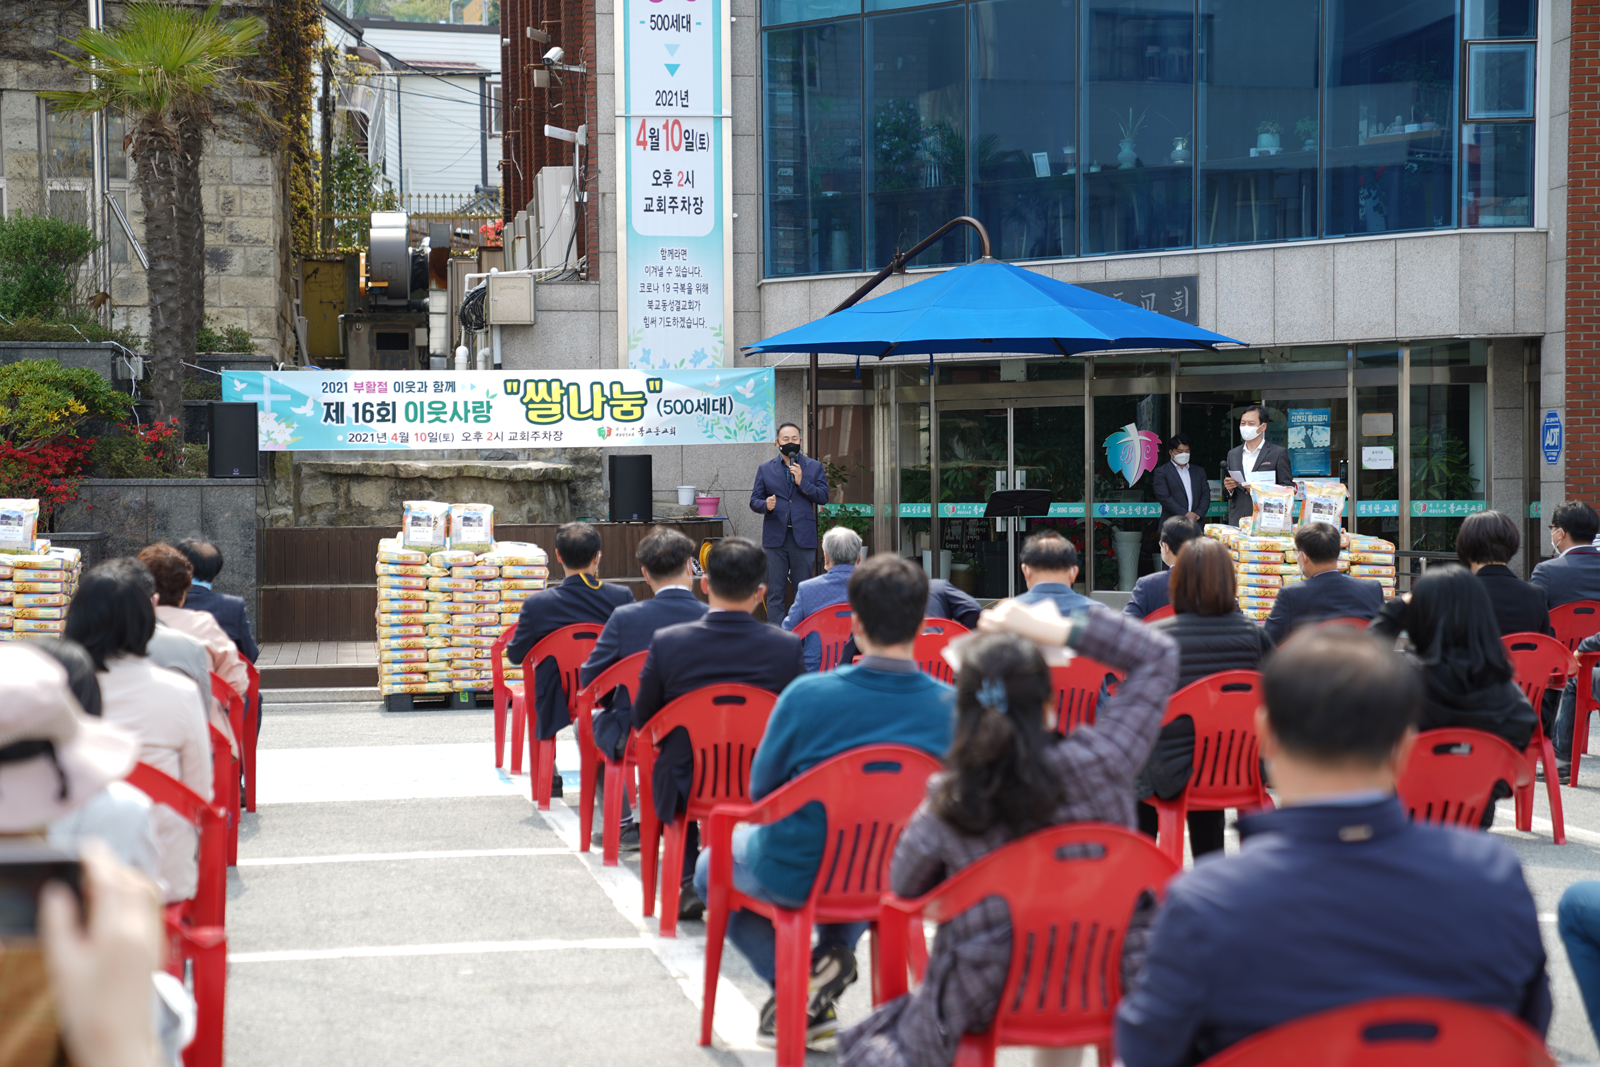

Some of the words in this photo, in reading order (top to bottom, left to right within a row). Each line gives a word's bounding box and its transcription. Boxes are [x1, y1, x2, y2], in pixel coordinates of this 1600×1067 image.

[650, 14, 691, 33] 500세대
[655, 89, 689, 108] 2021년
[636, 119, 660, 152] 4월
[662, 119, 710, 152] 10일(토)
[652, 169, 674, 188] 오후
[677, 170, 695, 188] 2시
[643, 195, 704, 215] 교회주차장
[660, 248, 687, 261] 함께라면
[644, 265, 664, 278] 이겨낼
[665, 266, 673, 277] 수
[674, 265, 703, 278] 있습니다.
[639, 282, 659, 294] 코로나
[662, 283, 671, 294] 19
[672, 283, 694, 295] 극복을
[695, 283, 709, 295] 위해
[647, 299, 701, 312] 북교동성결교회가
[643, 316, 657, 328] 힘써
[658, 316, 708, 329] 기도하겠습니다.
[321, 381, 348, 394] 2021
[353, 381, 388, 394] 부활절
[393, 381, 428, 394] 이웃과
[433, 380, 456, 393] 함께
[322, 401, 345, 424] 제
[352, 401, 397, 424] 16회
[404, 400, 493, 424] 이웃사랑
[656, 397, 734, 418] (500세대)
[348, 432, 387, 444] 2021년
[390, 432, 410, 443] 4월
[413, 431, 455, 443] 10일(토)
[461, 431, 483, 442] 오후
[487, 431, 503, 442] 2시
[508, 431, 564, 442] 교회주차장
[1544, 428, 1560, 447] ADT
[1382, 504, 1397, 514] 교회
